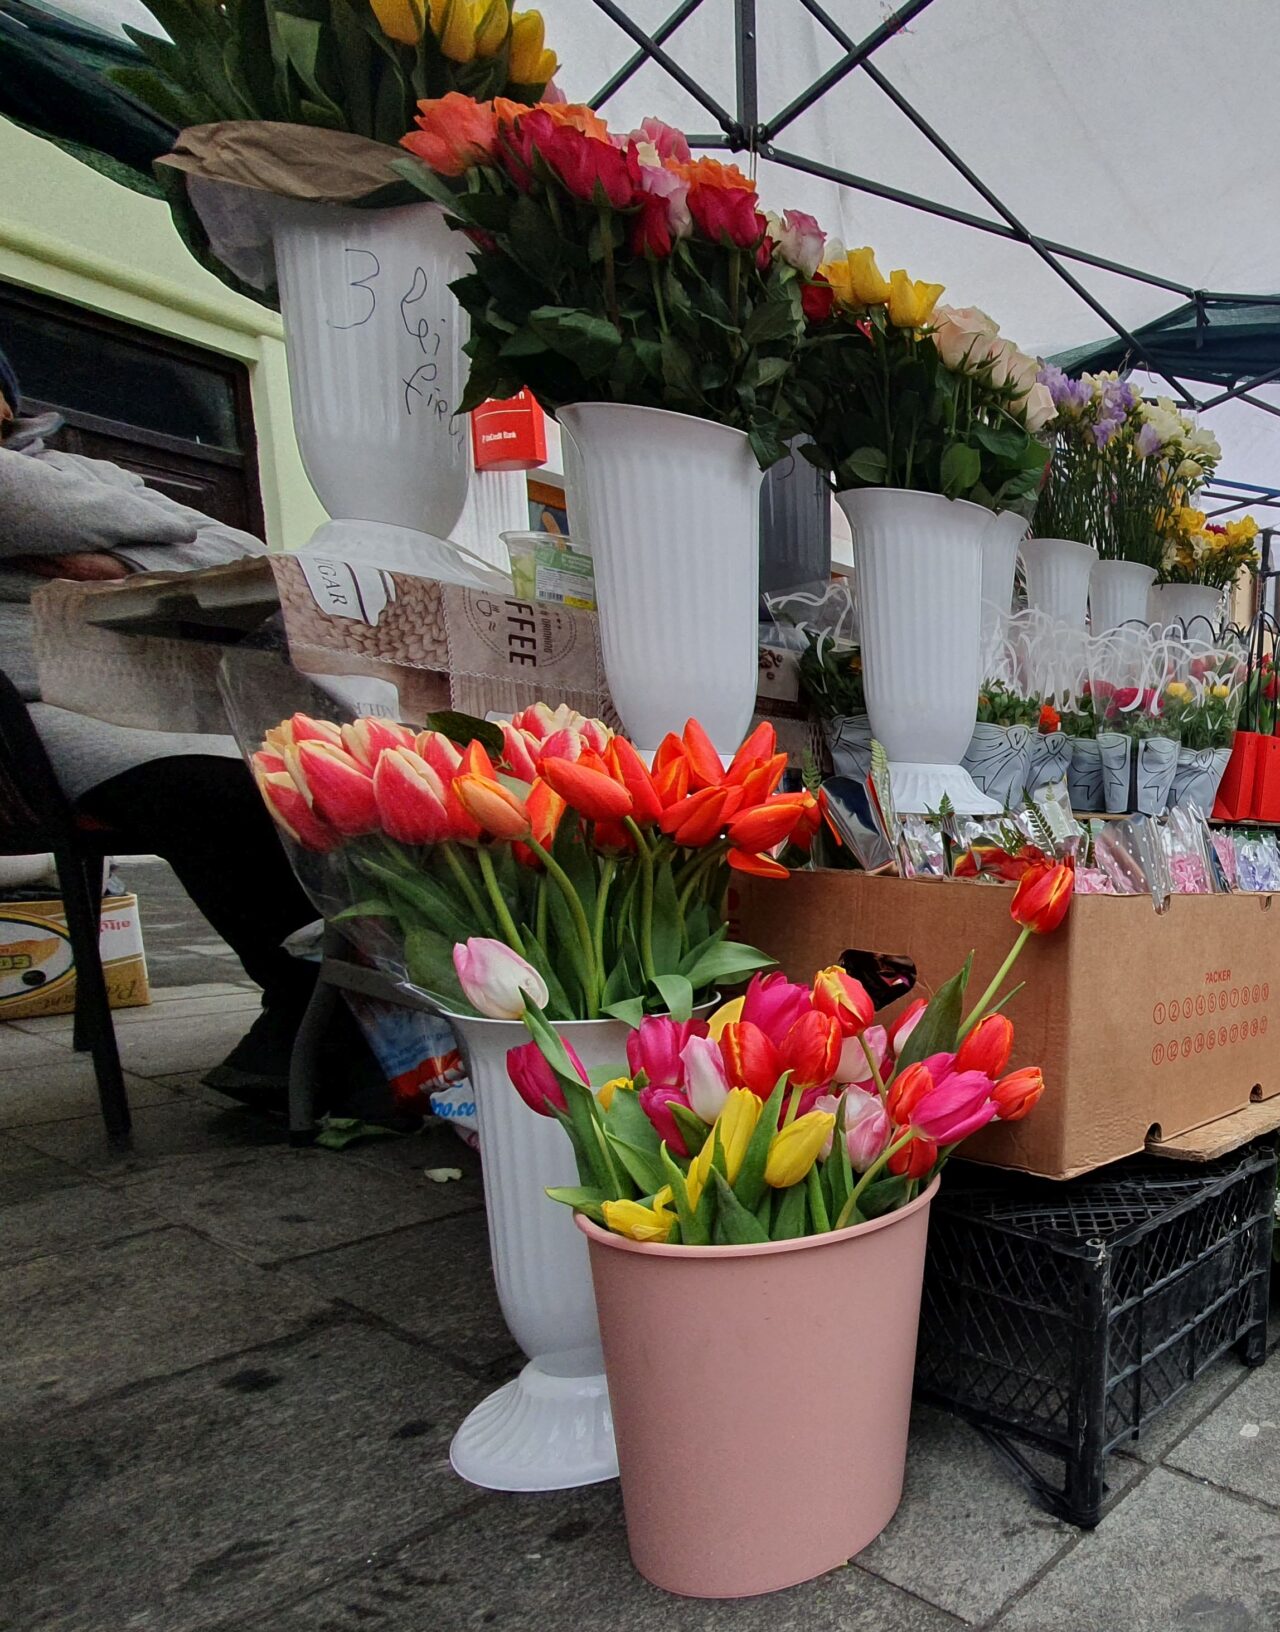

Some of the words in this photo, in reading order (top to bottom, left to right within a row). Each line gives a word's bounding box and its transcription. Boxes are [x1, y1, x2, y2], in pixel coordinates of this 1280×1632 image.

[326, 248, 380, 329] 3
[504, 600, 537, 667] FFEE
[1204, 969, 1231, 984] PACKER
